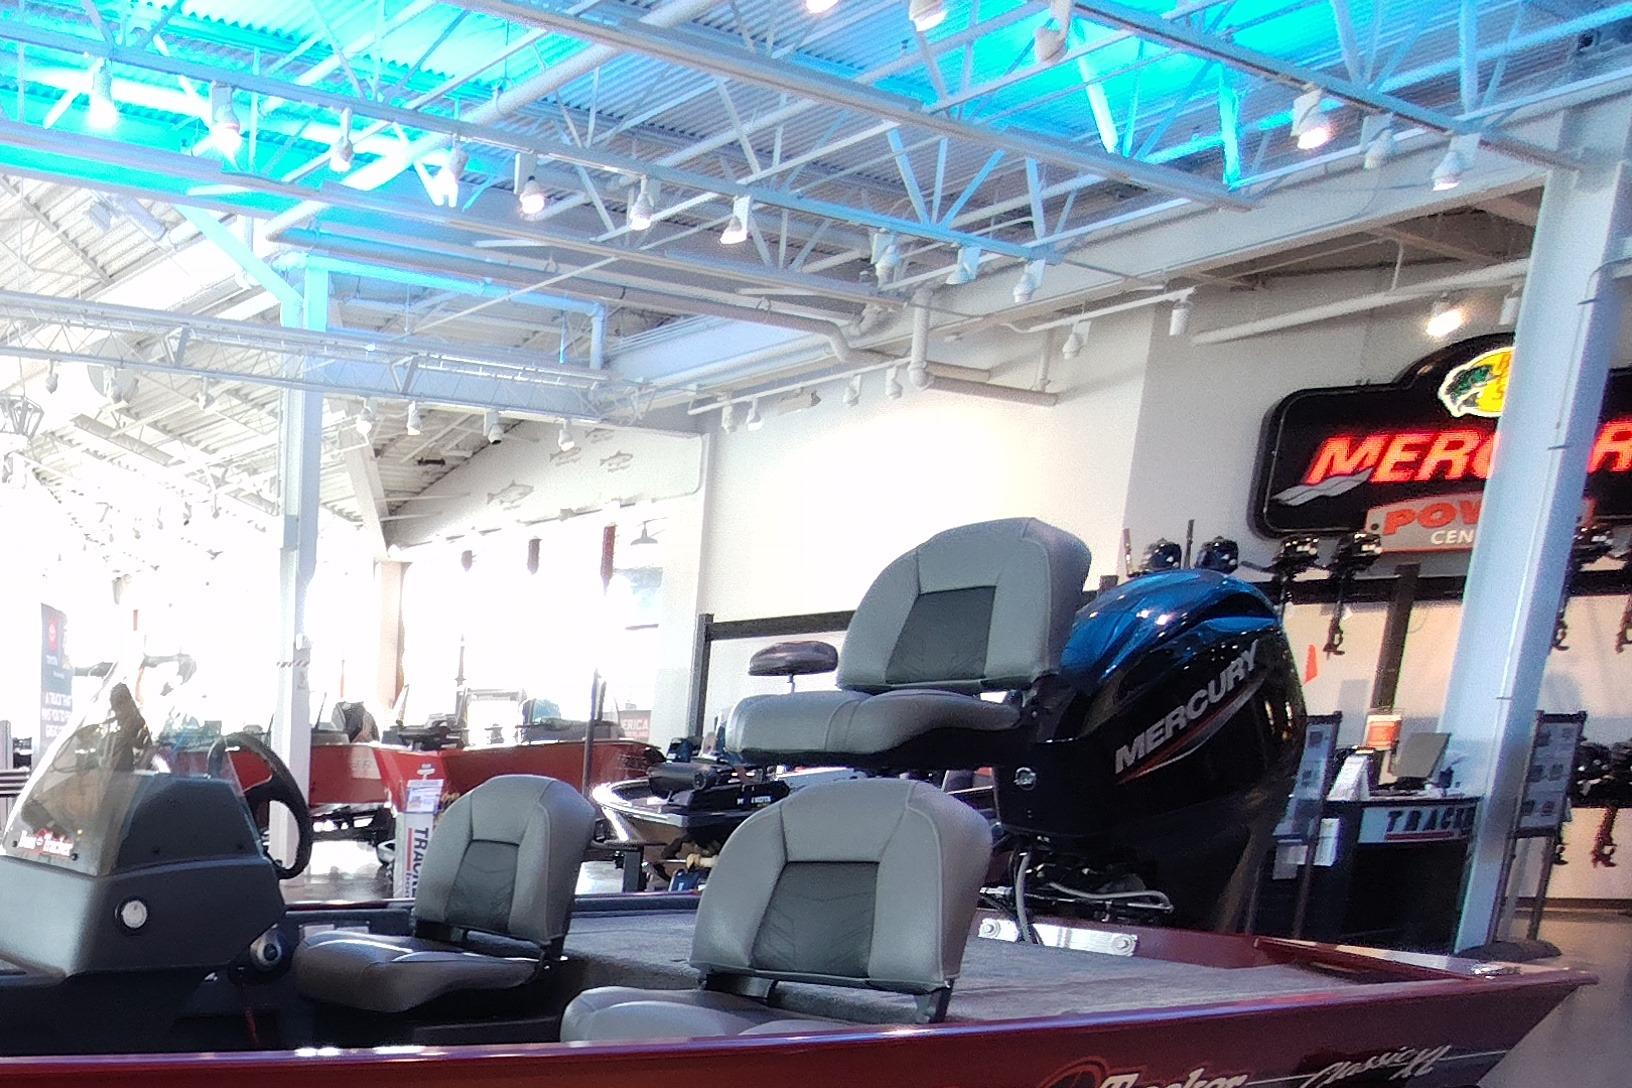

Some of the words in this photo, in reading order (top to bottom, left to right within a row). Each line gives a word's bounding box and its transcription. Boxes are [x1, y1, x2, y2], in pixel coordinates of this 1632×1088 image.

[1431, 529, 1474, 545] CEN
[1115, 639, 1259, 774] MERCURY
[623, 719, 649, 730] ERICA
